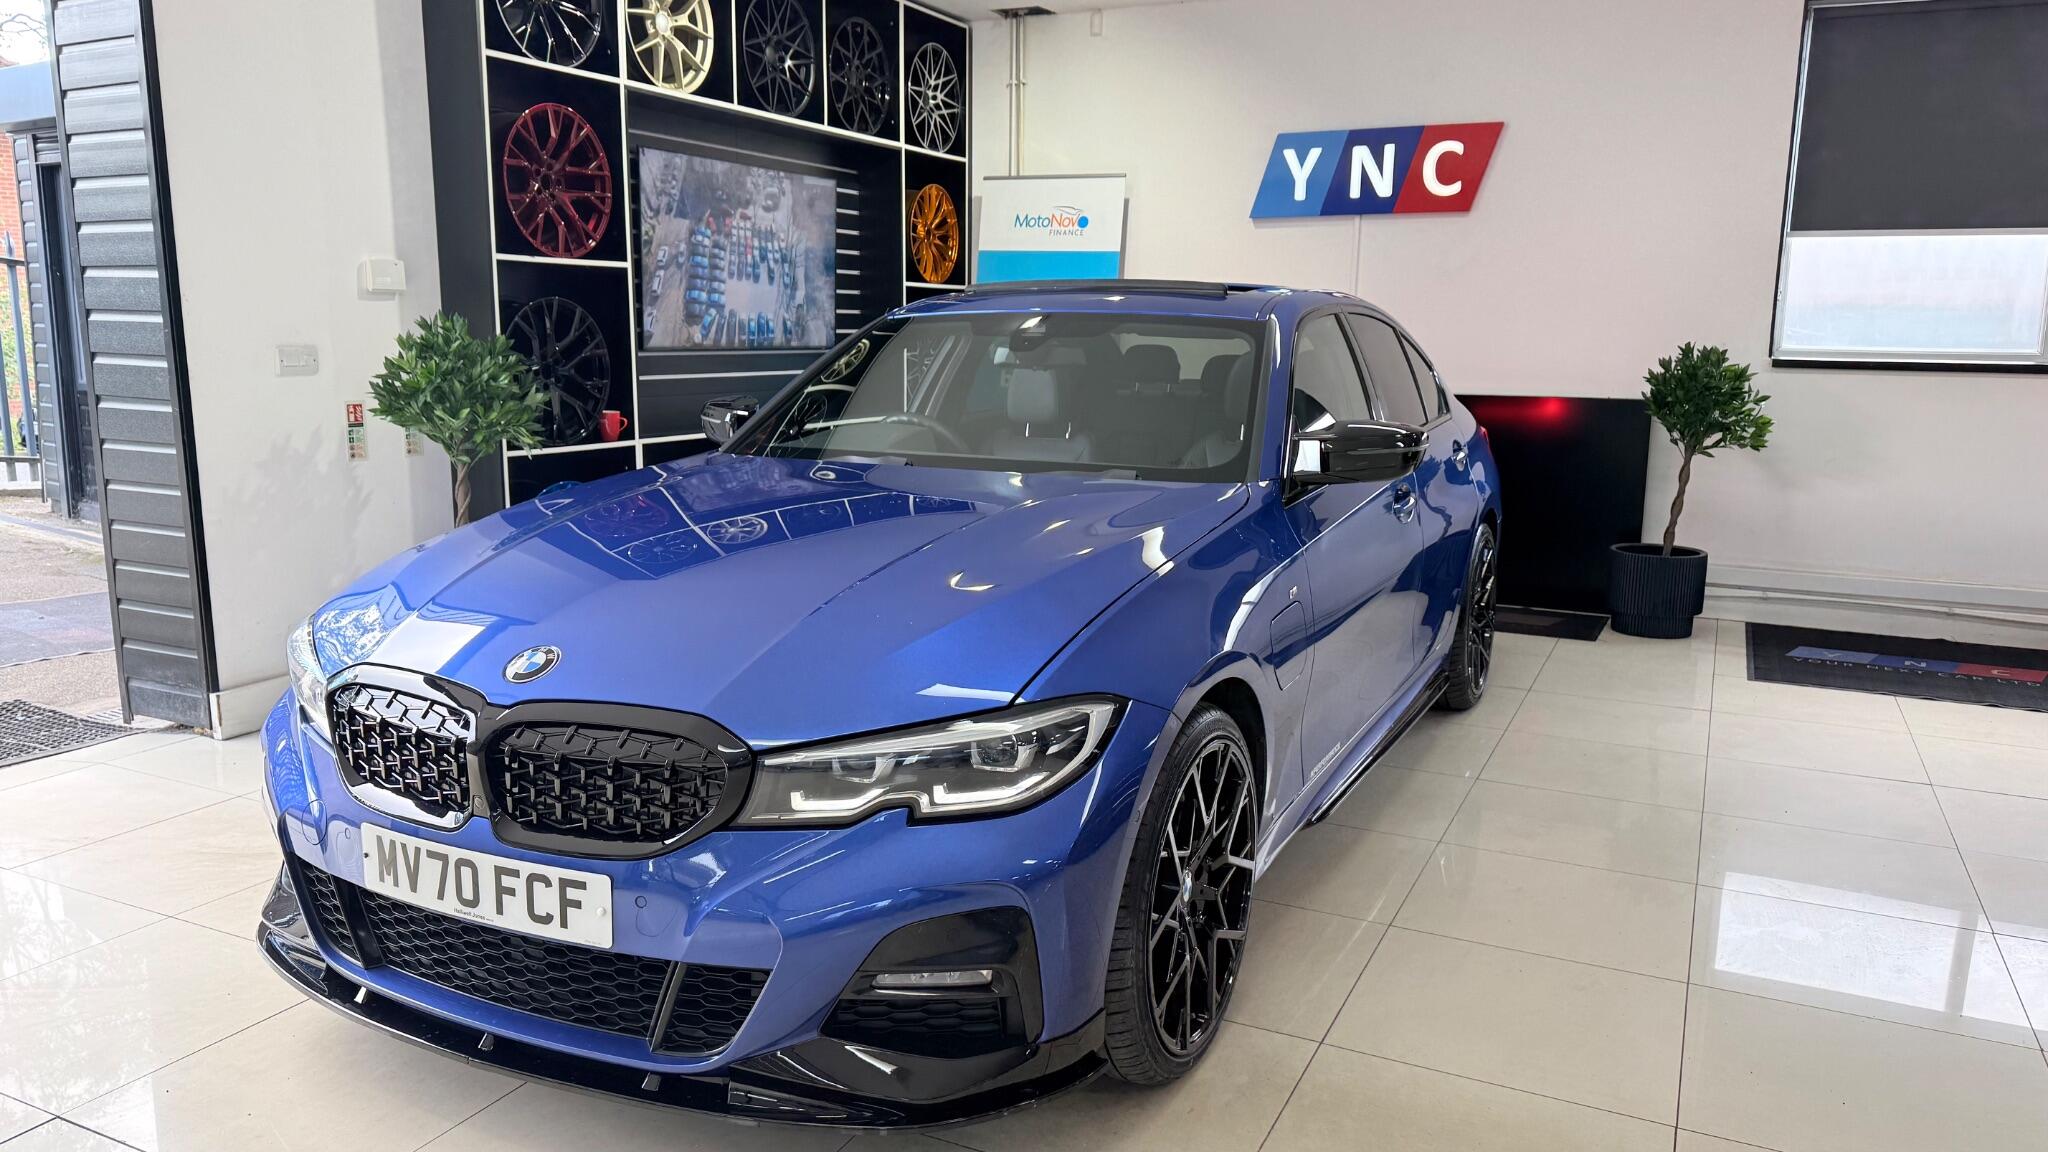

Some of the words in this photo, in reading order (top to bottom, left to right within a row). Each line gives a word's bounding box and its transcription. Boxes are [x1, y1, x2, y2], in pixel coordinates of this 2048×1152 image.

[1283, 140, 1464, 201] YNC
[1014, 212, 1089, 229] MotoNovo
[376, 834, 480, 909] MV70
[494, 864, 587, 930] FCF
